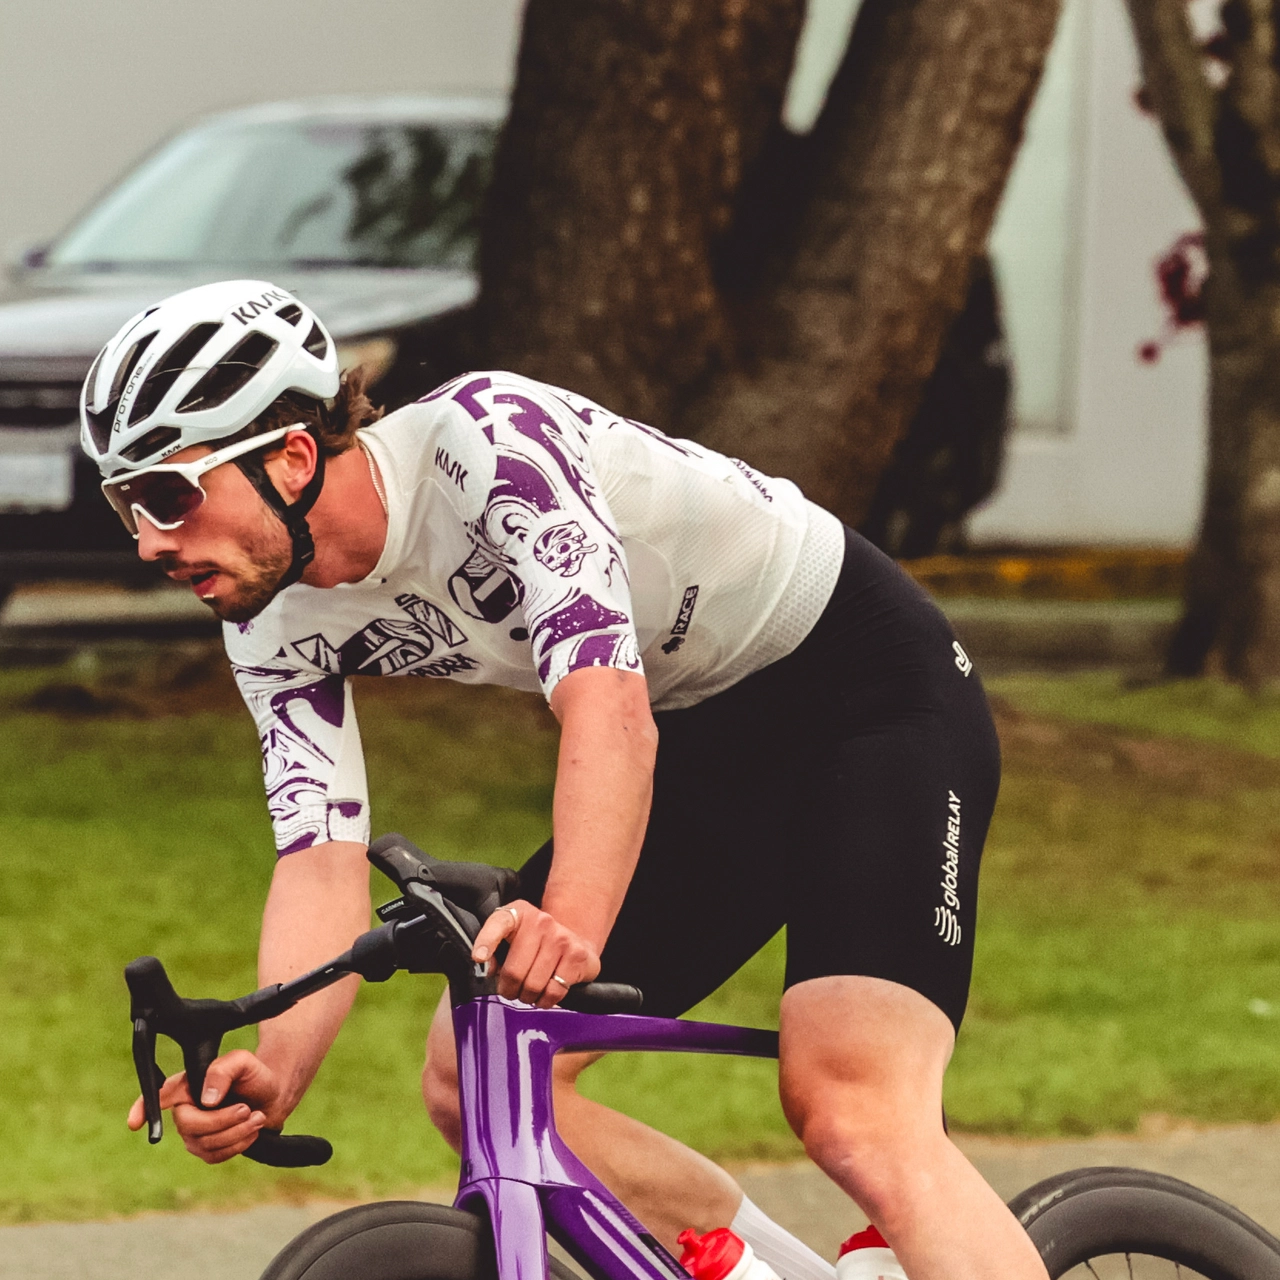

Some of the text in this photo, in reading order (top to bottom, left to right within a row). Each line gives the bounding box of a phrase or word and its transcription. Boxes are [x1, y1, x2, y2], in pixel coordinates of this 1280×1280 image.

[231, 290, 289, 326] KASK
[161, 444, 182, 458] KASK
[435, 446, 468, 493] KASK
[673, 588, 698, 633] RACE
